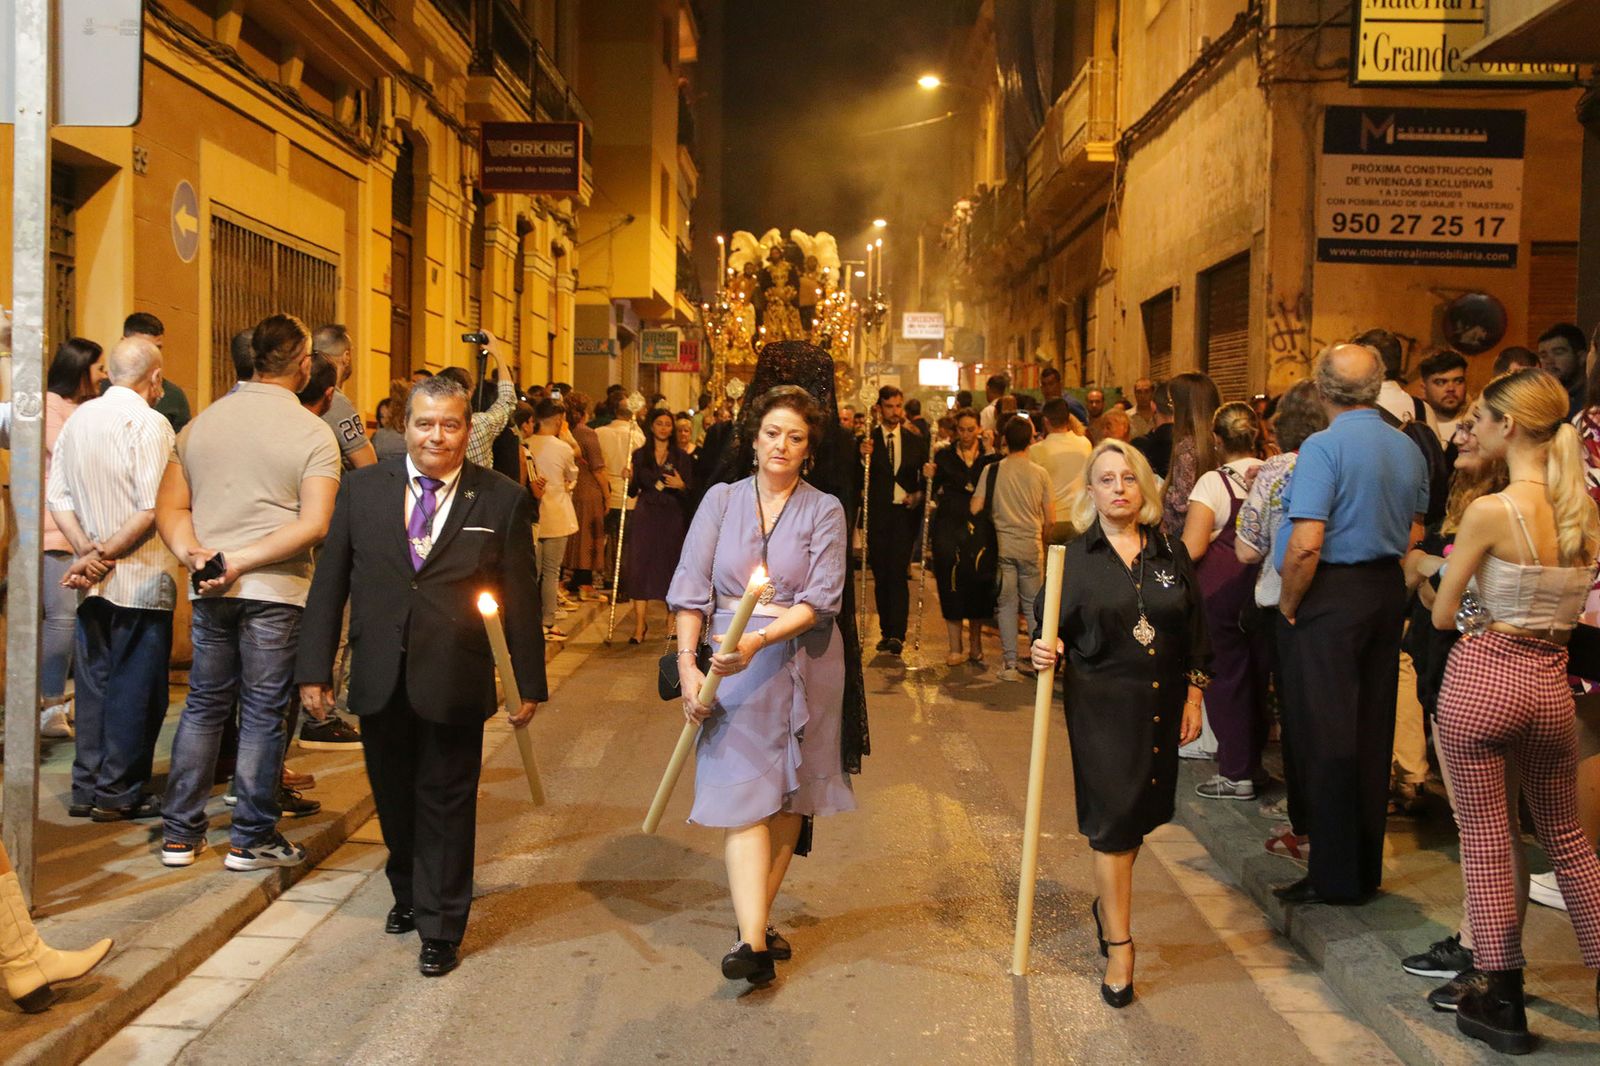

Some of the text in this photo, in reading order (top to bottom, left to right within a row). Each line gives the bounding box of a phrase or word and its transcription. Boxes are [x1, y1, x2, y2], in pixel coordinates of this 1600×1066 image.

[486, 140, 575, 157] WORKING
[485, 165, 572, 174] prendas de trabajo
[1351, 163, 1493, 176] PRÓXIMA CONSTRUCCIÓN
[1346, 176, 1494, 189] DE VIVIENDAS EXCLUSIVAS
[1400, 189, 1463, 198] DORMITORIOS
[1347, 199, 1404, 207] POSIBILIDAD
[1406, 200, 1417, 208] DE
[1466, 201, 1514, 210] TRASTERO
[1332, 212, 1506, 237] 950 27 25 17
[1329, 247, 1510, 262] www.monterrealinmobiliaria.com
